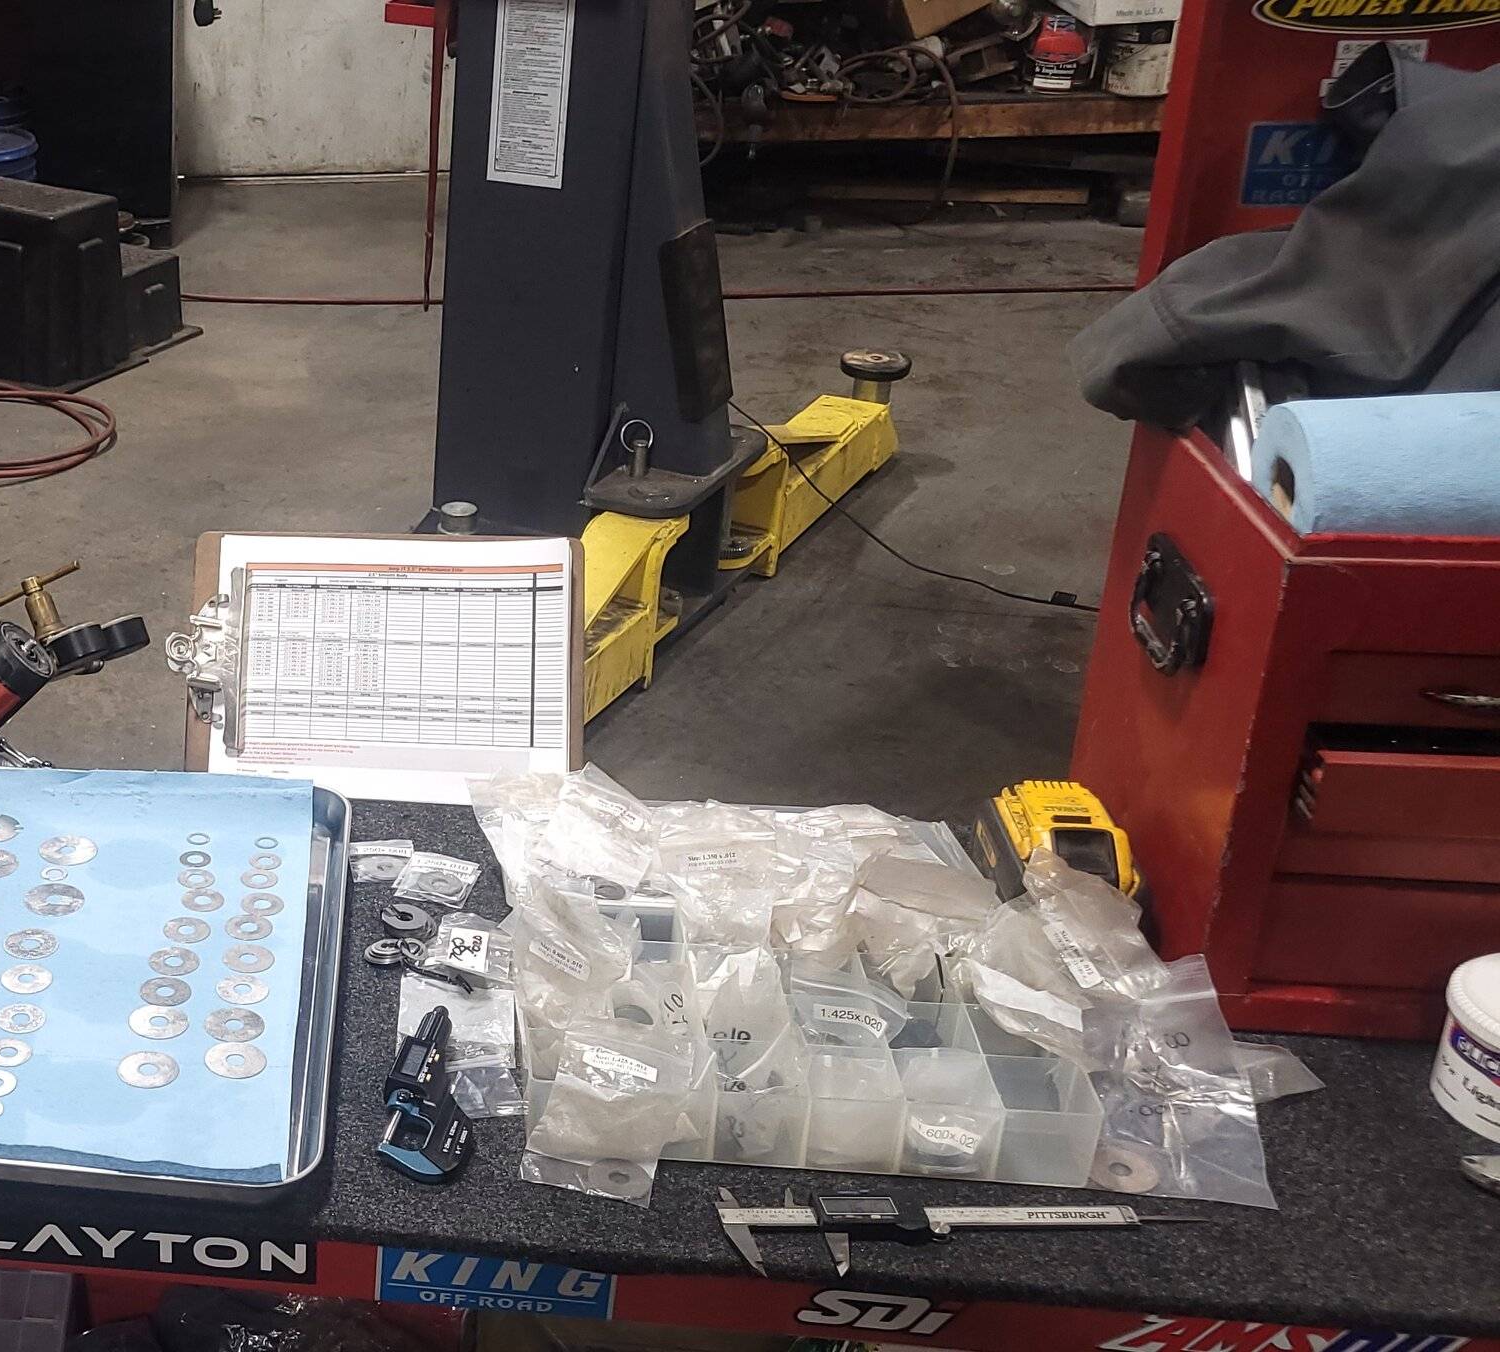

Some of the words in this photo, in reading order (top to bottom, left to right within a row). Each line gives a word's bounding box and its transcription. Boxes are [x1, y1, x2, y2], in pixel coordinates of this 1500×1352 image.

[820, 1008, 883, 1032] 1.425x.020
[1457, 1036, 1500, 1077] SLIC
[1027, 1210, 1107, 1221] PITTSBURGH
[389, 1251, 610, 1299] KING
[419, 1288, 553, 1314] OFF-ROAD
[797, 1289, 964, 1335] SDi
